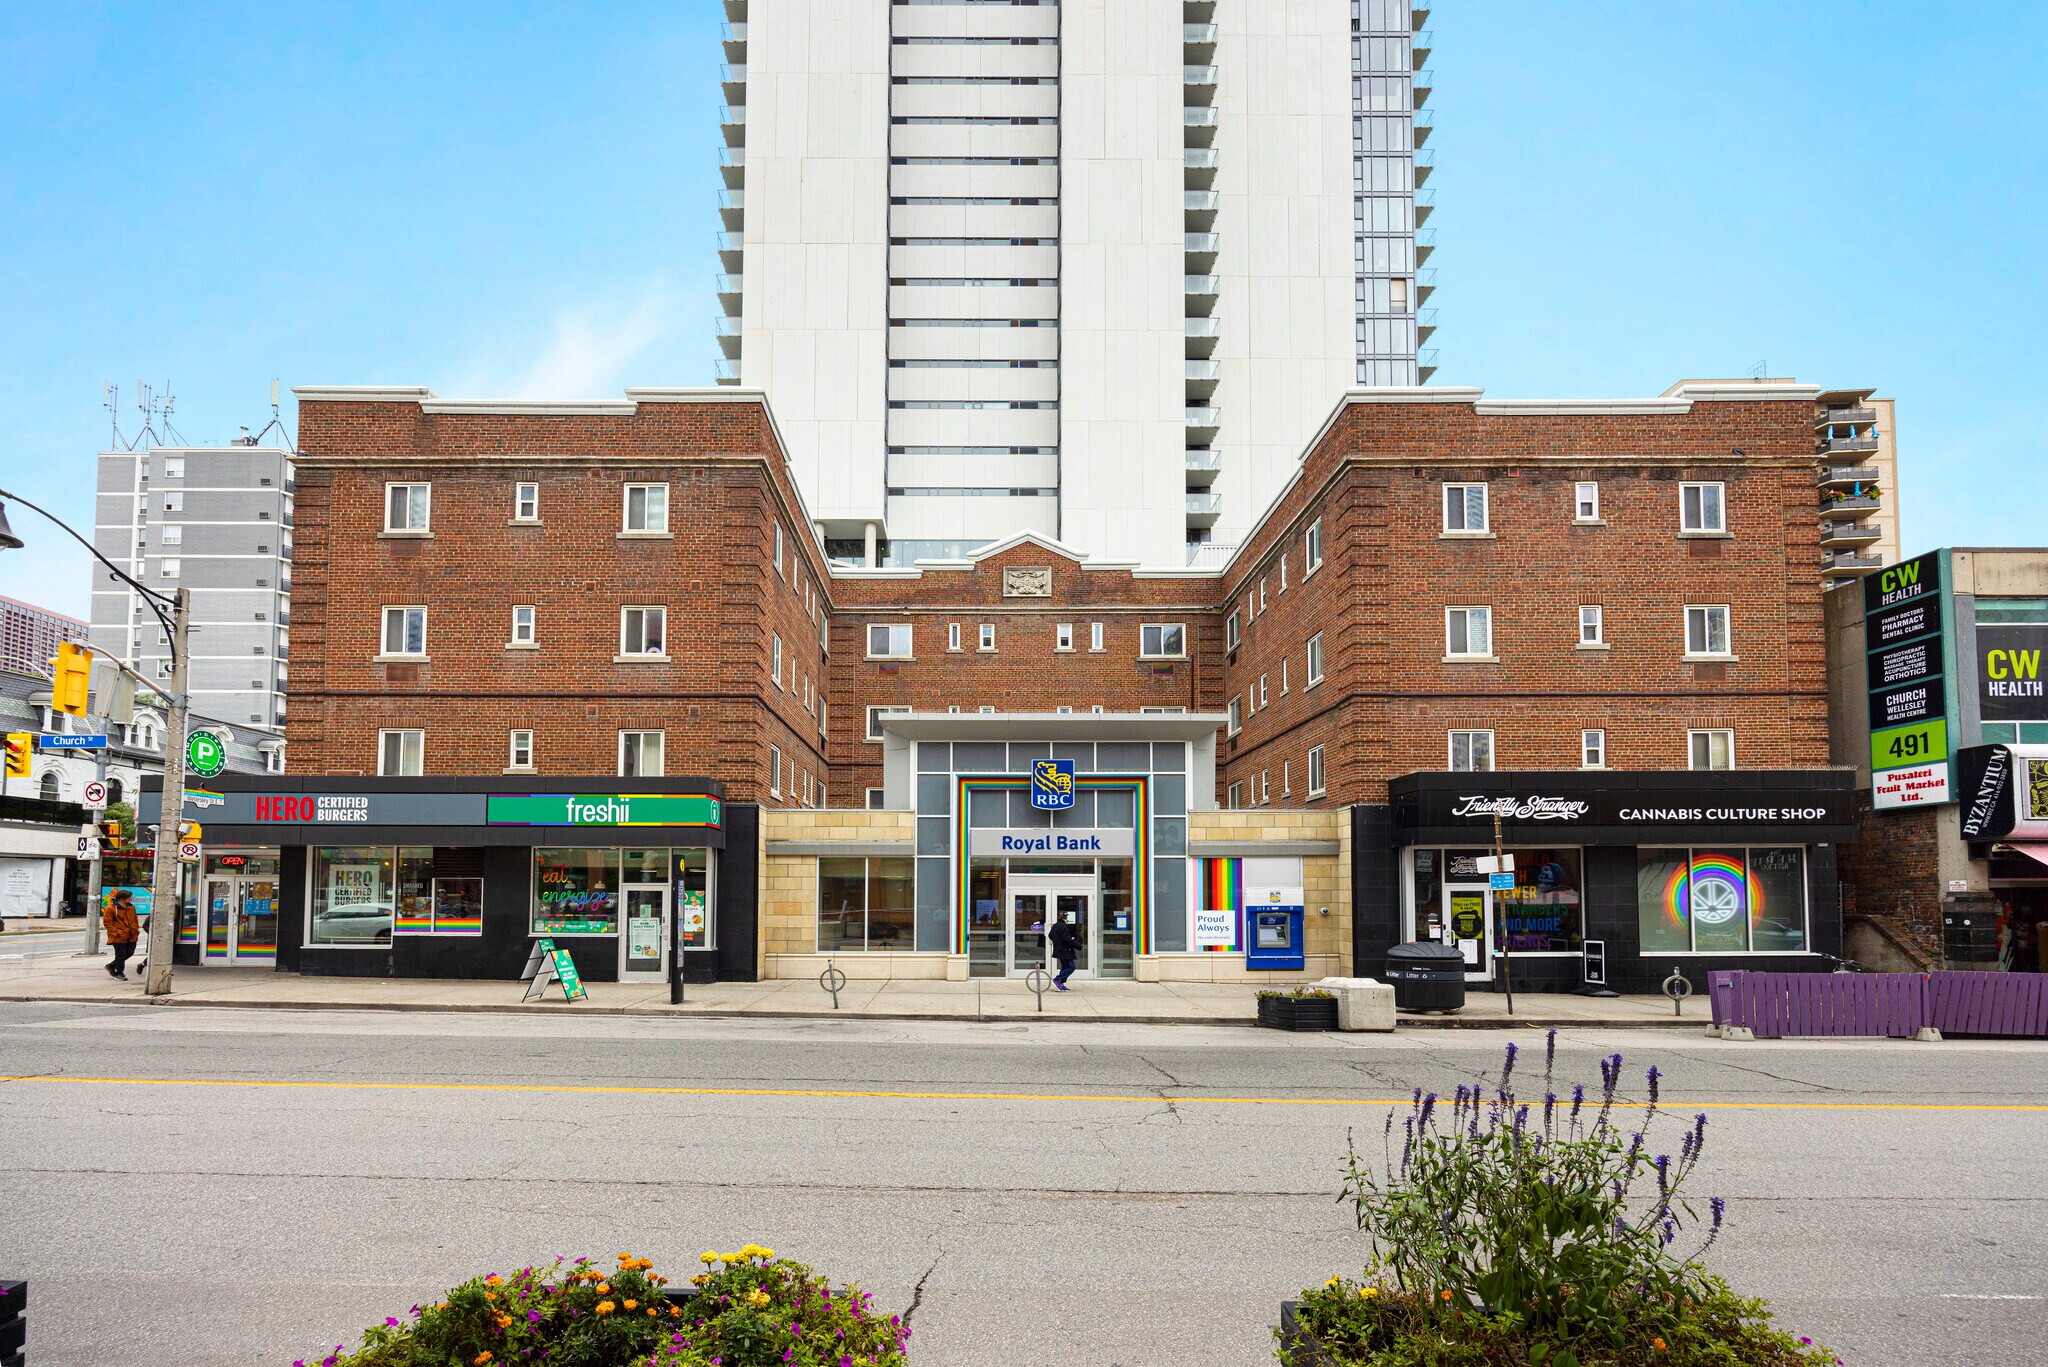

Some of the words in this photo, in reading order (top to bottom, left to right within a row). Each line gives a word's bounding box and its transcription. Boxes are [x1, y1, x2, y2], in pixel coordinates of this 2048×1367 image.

[1881, 560, 1920, 593] CW
[1882, 582, 1922, 606] HEALTH
[1881, 615, 1899, 625] FAMILY
[1900, 607, 1924, 618] DOCTORS
[1882, 614, 1924, 632] PHARMACY
[1882, 631, 1904, 640] DENTAL
[1904, 623, 1925, 633] CLINIC
[1883, 645, 1926, 661] PHYSIOTHERAPY
[1883, 651, 1926, 666] CHIROPRACTIC
[1884, 661, 1905, 670] MASSAGE
[1905, 656, 1926, 664] THERAPY
[1884, 661, 1927, 676] ACUPUNCTURE
[1987, 649, 2041, 680] CW
[1884, 667, 1927, 682] ORTHOTICS
[1886, 688, 1926, 706] CHURCH
[1988, 681, 2043, 697] HEALTH
[1887, 699, 1926, 714] WELLESLEY
[1887, 712, 1906, 721] HEALTH
[1906, 708, 1927, 717] CENTRE
[53, 736, 86, 745] Church
[1889, 731, 1929, 758] 491
[198, 741, 214, 760] P
[1887, 768, 1932, 782] Pusateri
[1876, 784, 1901, 794] Fruit
[1905, 778, 1945, 791] Market
[1963, 748, 2008, 835] BYZANTIUM
[1036, 794, 1070, 805] RBC
[1901, 792, 1924, 802] Ltd.
[255, 796, 315, 821] HERO
[317, 796, 369, 808] CERTIFIED
[317, 809, 368, 822] BURGERS
[566, 798, 630, 822] freshii
[1452, 795, 1519, 817] Friendly
[1515, 795, 1589, 820] Stranger
[1619, 808, 1703, 820] CANNABIS
[1705, 808, 1778, 820] CULTURE
[1781, 808, 1826, 820] SHOP
[1002, 835, 1051, 854] Royal
[1056, 835, 1101, 850] Bank
[222, 857, 245, 865] OPEN
[335, 870, 373, 887] HERO
[335, 888, 372, 896] CERTIFIED
[542, 889, 609, 911] energize
[334, 896, 372, 906] BURGERS
[1197, 914, 1225, 923] Proud
[1526, 918, 1561, 932] MORE
[1197, 924, 1230, 934] Always
